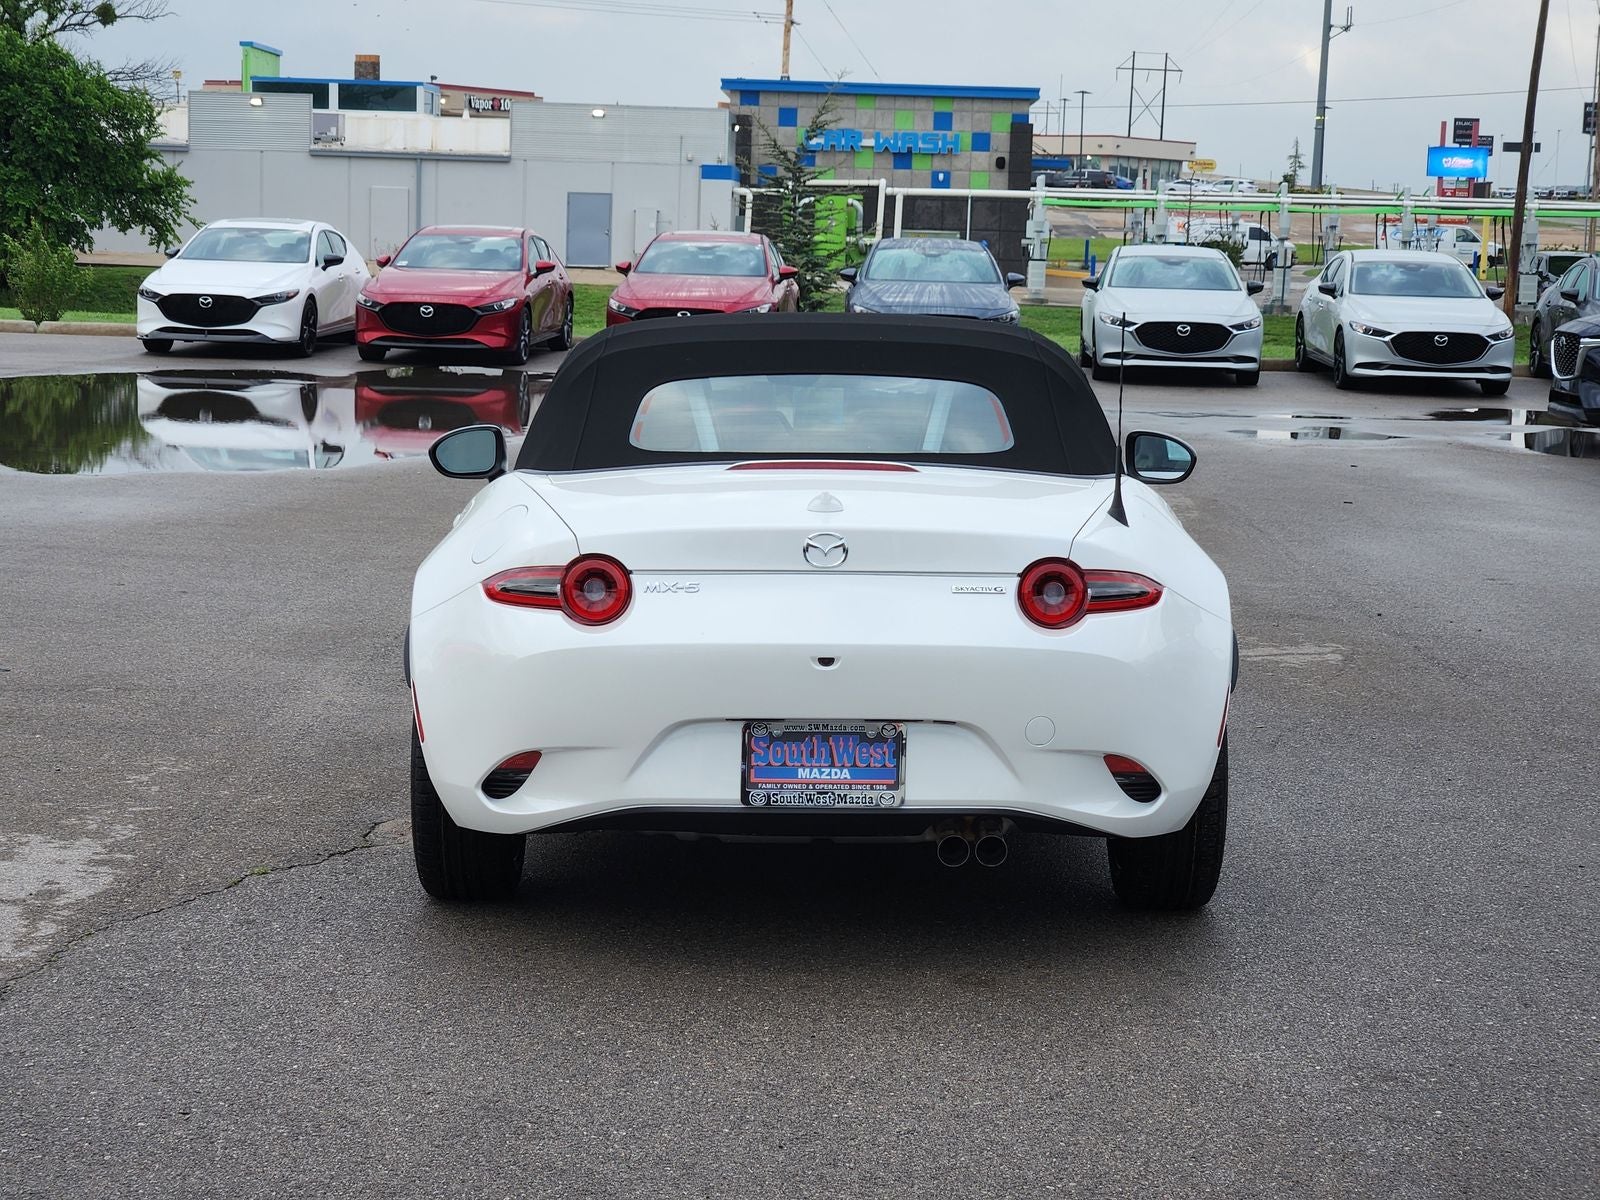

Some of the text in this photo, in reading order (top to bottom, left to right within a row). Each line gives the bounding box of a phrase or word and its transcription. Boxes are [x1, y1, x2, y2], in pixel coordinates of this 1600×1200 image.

[470, 95, 492, 112] Vapor
[803, 128, 960, 154] CAR WASH
[643, 582, 701, 593] MX-5
[784, 723, 866, 732] www.SWMazda.com
[797, 768, 851, 779] MAZDA
[836, 793, 875, 805] Mazda
